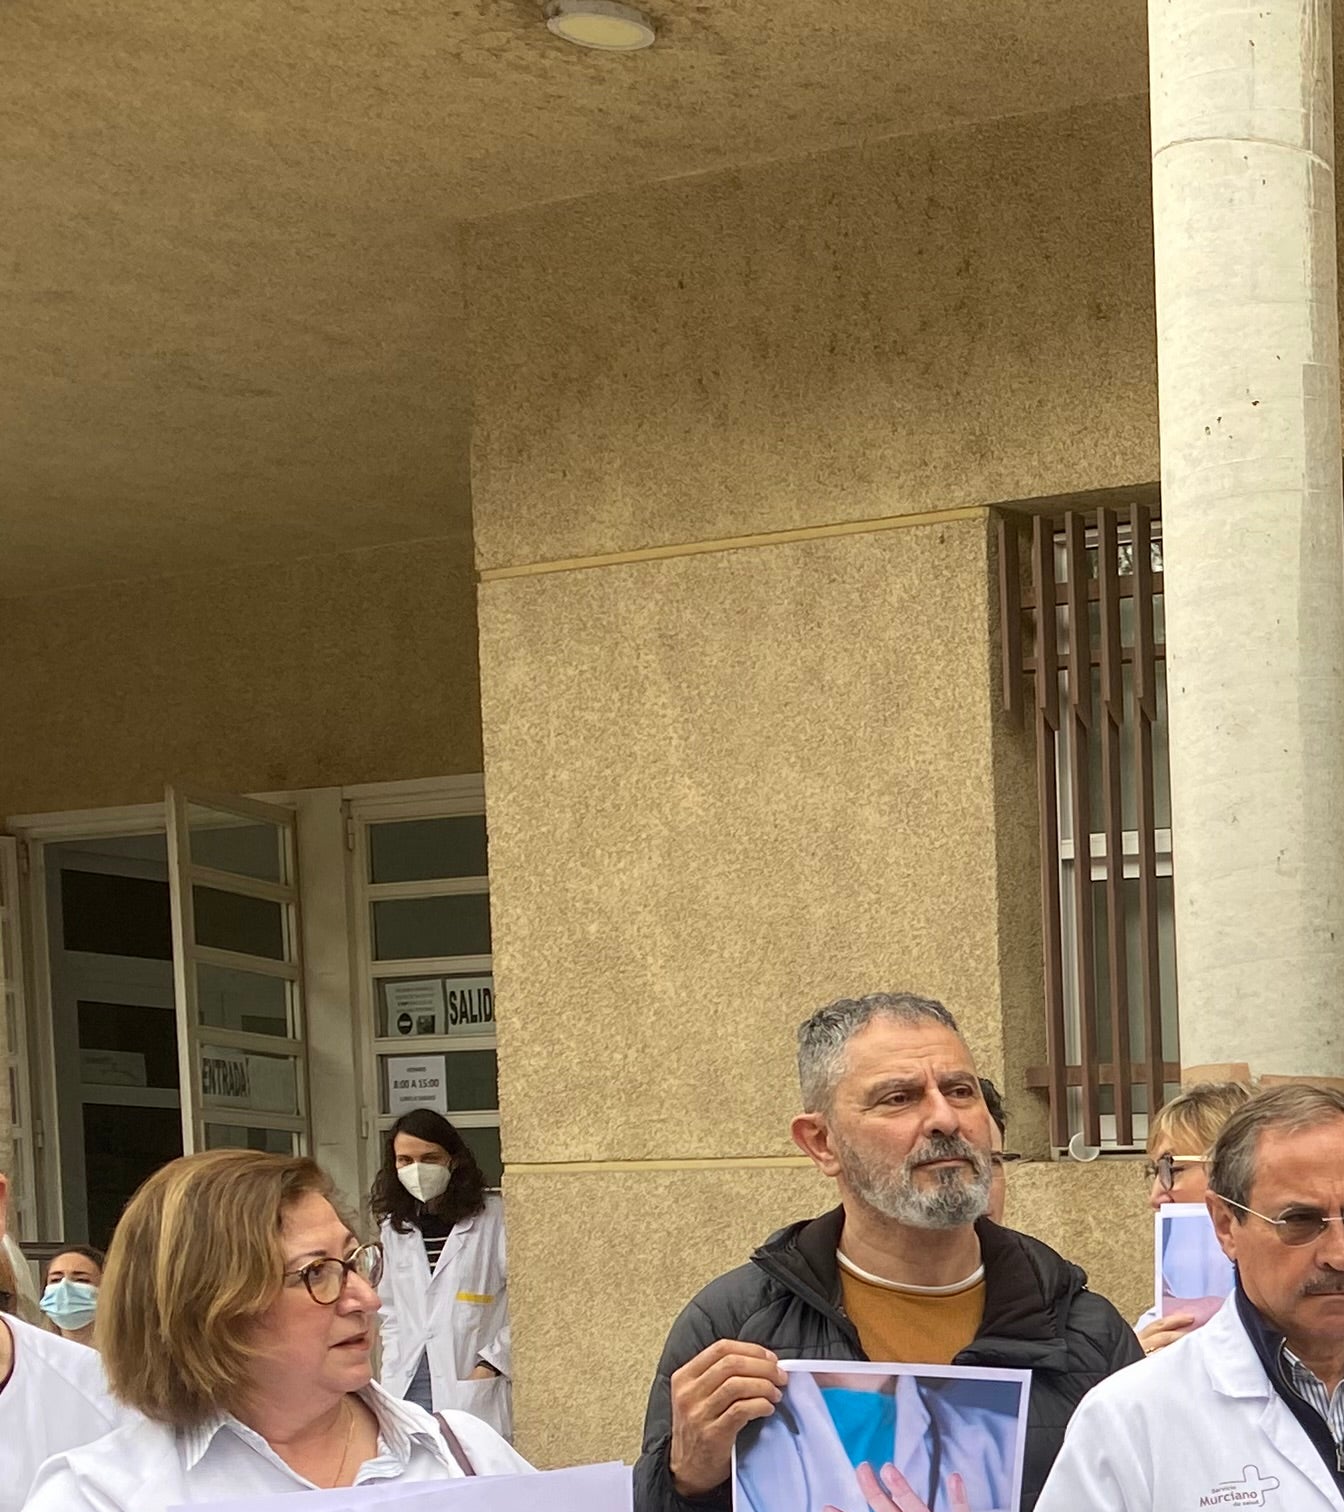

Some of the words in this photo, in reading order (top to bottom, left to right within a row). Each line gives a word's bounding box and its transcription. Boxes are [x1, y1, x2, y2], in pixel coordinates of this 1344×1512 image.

[448, 988, 495, 1025] SALID
[203, 1058, 248, 1096] ENTRADA
[1200, 1491, 1258, 1507] Murciano
